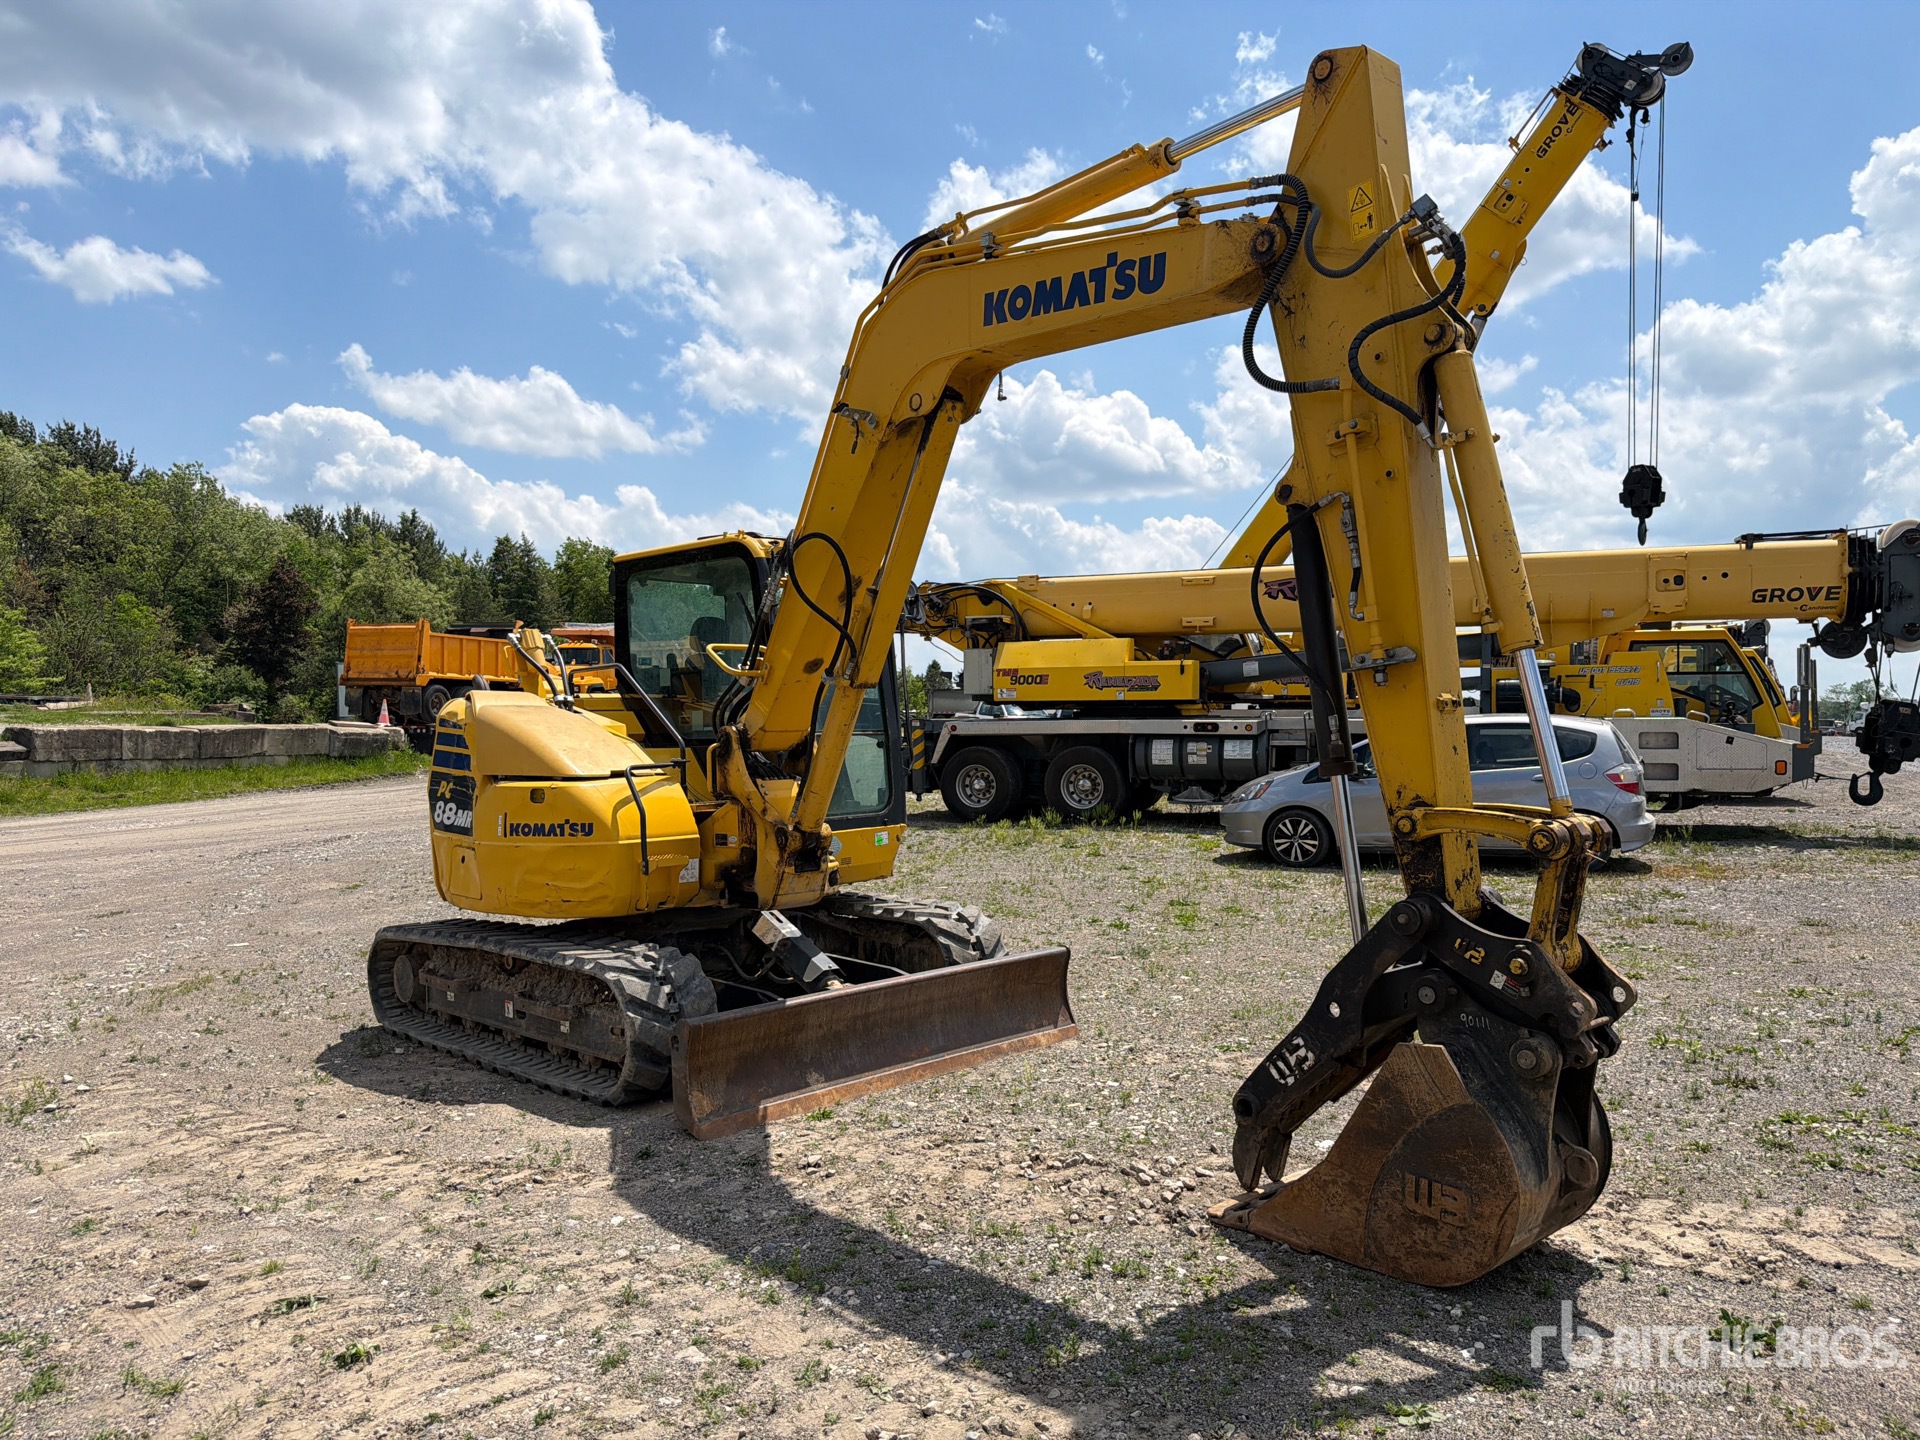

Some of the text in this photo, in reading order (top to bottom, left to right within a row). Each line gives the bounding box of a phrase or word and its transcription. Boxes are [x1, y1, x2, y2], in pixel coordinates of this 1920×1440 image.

[1536, 102, 1580, 159] GROVE
[983, 251, 1167, 327] KOMATSU
[1751, 585, 1843, 603] GROVE
[995, 668, 1019, 677] TMS
[1009, 673, 1049, 686] 9000E
[1579, 667, 1590, 675] US
[1590, 666, 1607, 674] DOT
[1084, 671, 1161, 690] RENEGADE
[436, 780, 454, 799] PC
[509, 819, 594, 837] KOMATSU
